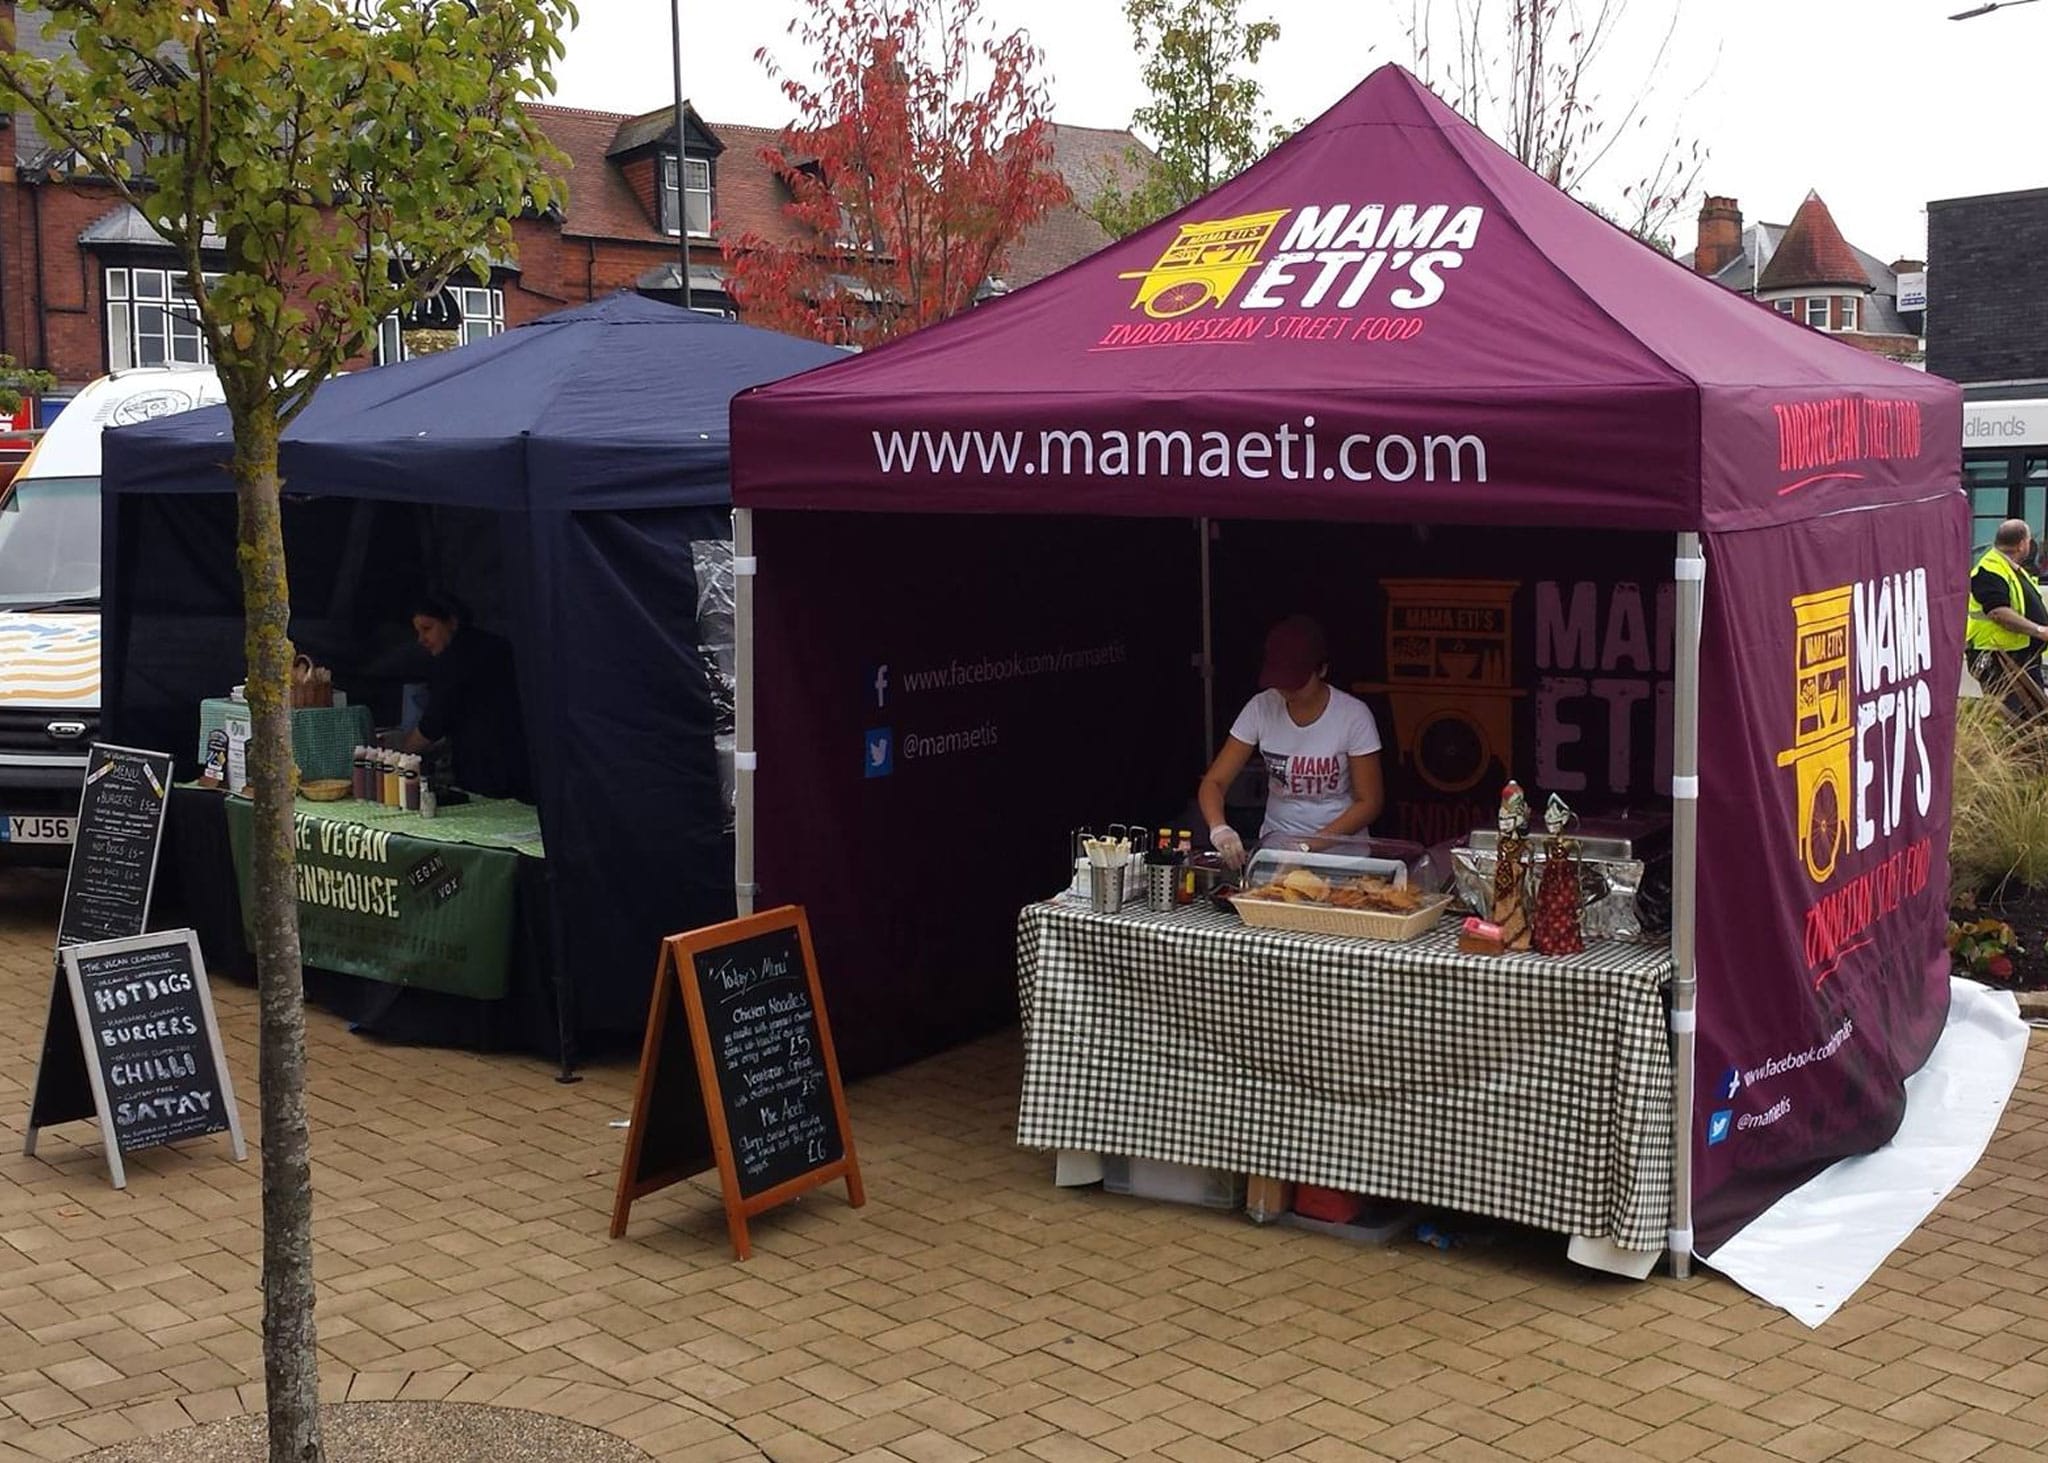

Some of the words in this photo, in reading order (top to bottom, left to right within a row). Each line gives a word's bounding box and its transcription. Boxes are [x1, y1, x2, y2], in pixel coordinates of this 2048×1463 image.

[1279, 204, 1484, 251] MAMA
[1239, 250, 1463, 309] ETI'S
[1100, 316, 1264, 345] INDONESIAN
[1264, 316, 1352, 340] STREET
[1351, 317, 1424, 341] FOOD
[871, 415, 1488, 483] www.mamaeti.com
[1773, 397, 1860, 472] INDONESIAN
[903, 721, 999, 759] @mamaetis
[1291, 755, 1340, 776] MAMA
[1855, 678, 1931, 850] ETI'S
[1291, 772, 1340, 795] ETI'S
[12, 818, 69, 839] YJ56
[321, 818, 391, 864] VEGAN
[407, 856, 443, 887] VEGAN
[732, 1003, 767, 1024] Chicken
[767, 992, 808, 1015] Noodles
[101, 1015, 198, 1047] BURGERS
[790, 1034, 811, 1057] £5
[111, 1052, 197, 1086] CHILLI
[117, 1090, 212, 1126] SATAY
[808, 1138, 826, 1164] £6
